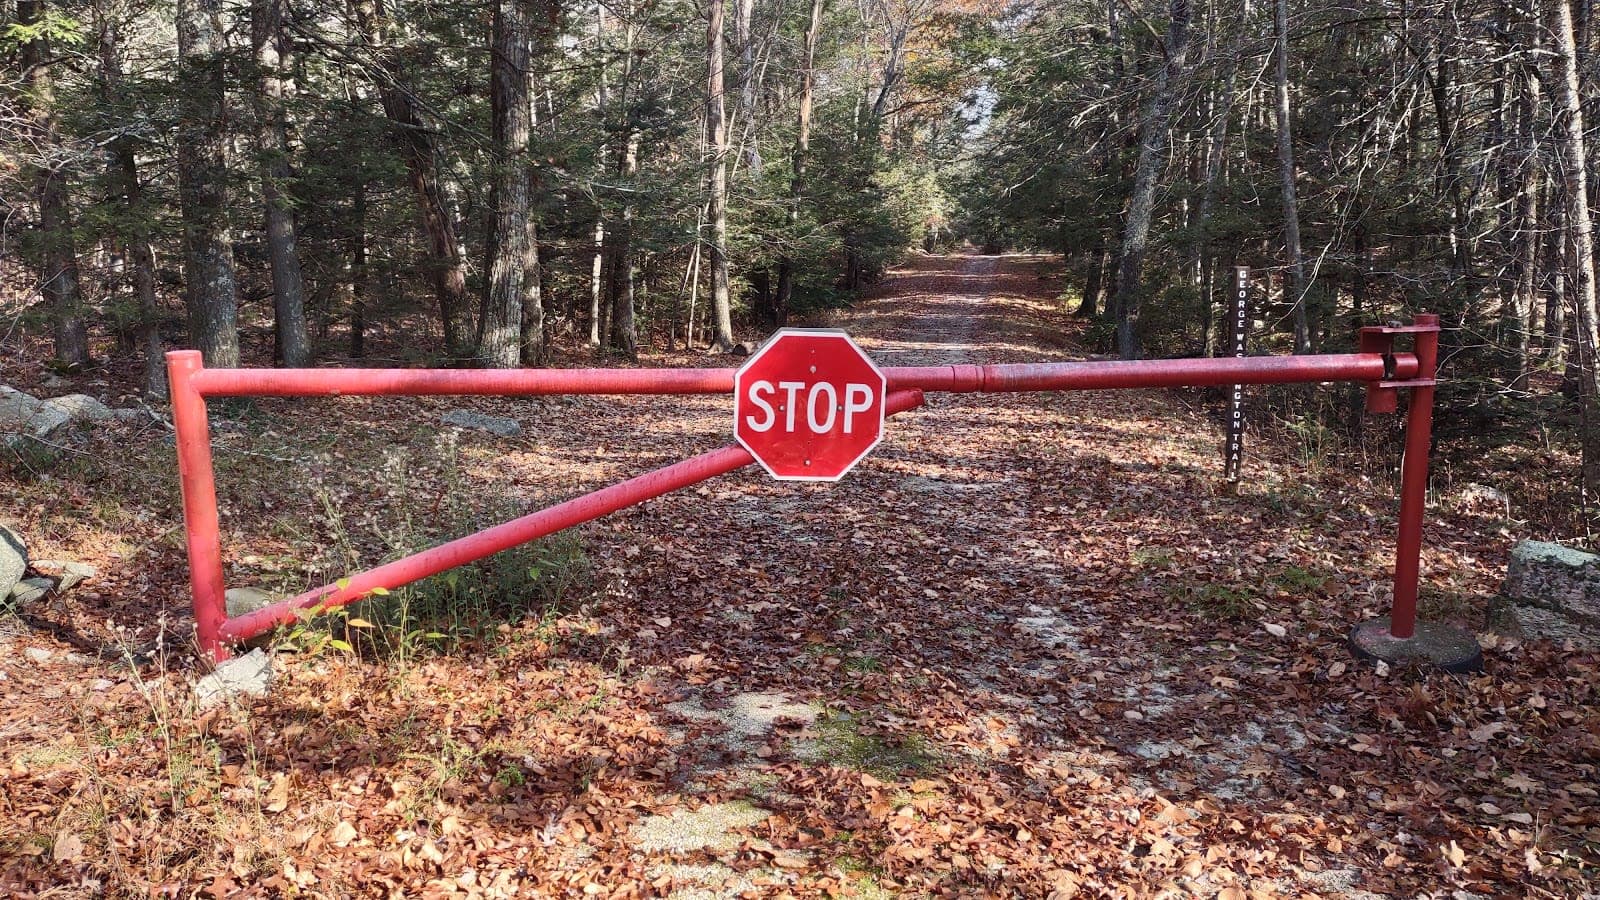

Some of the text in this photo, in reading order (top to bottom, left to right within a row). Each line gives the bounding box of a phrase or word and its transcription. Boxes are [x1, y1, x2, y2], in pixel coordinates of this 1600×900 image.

[746, 380, 874, 434] STOP
[1231, 270, 1247, 479] GEORGE WASNGTON TRAIL
